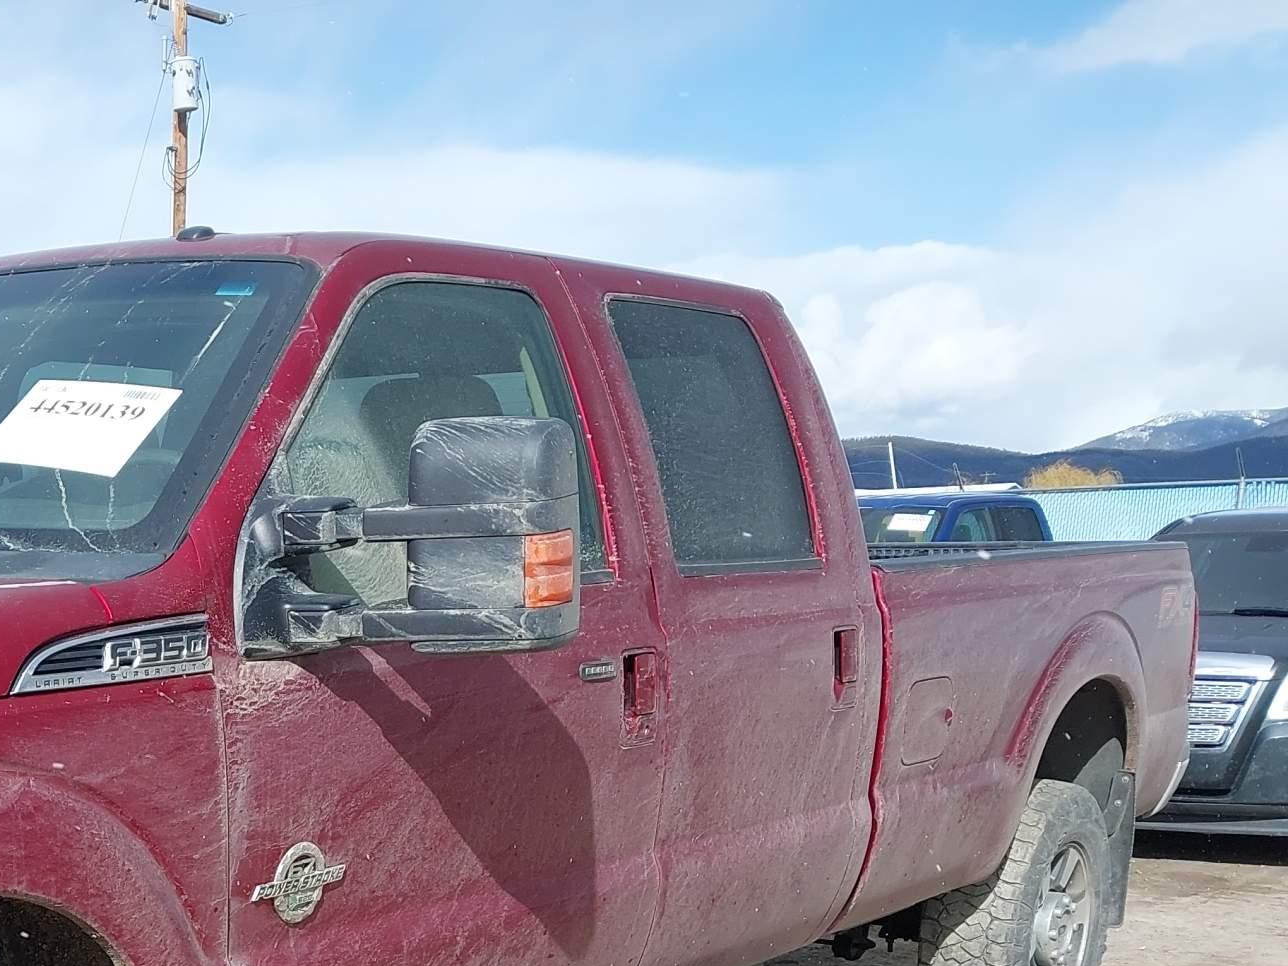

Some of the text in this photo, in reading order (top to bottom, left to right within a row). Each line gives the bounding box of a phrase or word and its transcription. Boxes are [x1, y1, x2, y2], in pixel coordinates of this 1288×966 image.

[29, 398, 146, 421] 44520139
[34, 662, 209, 689] LARIAT SUPER DUTY
